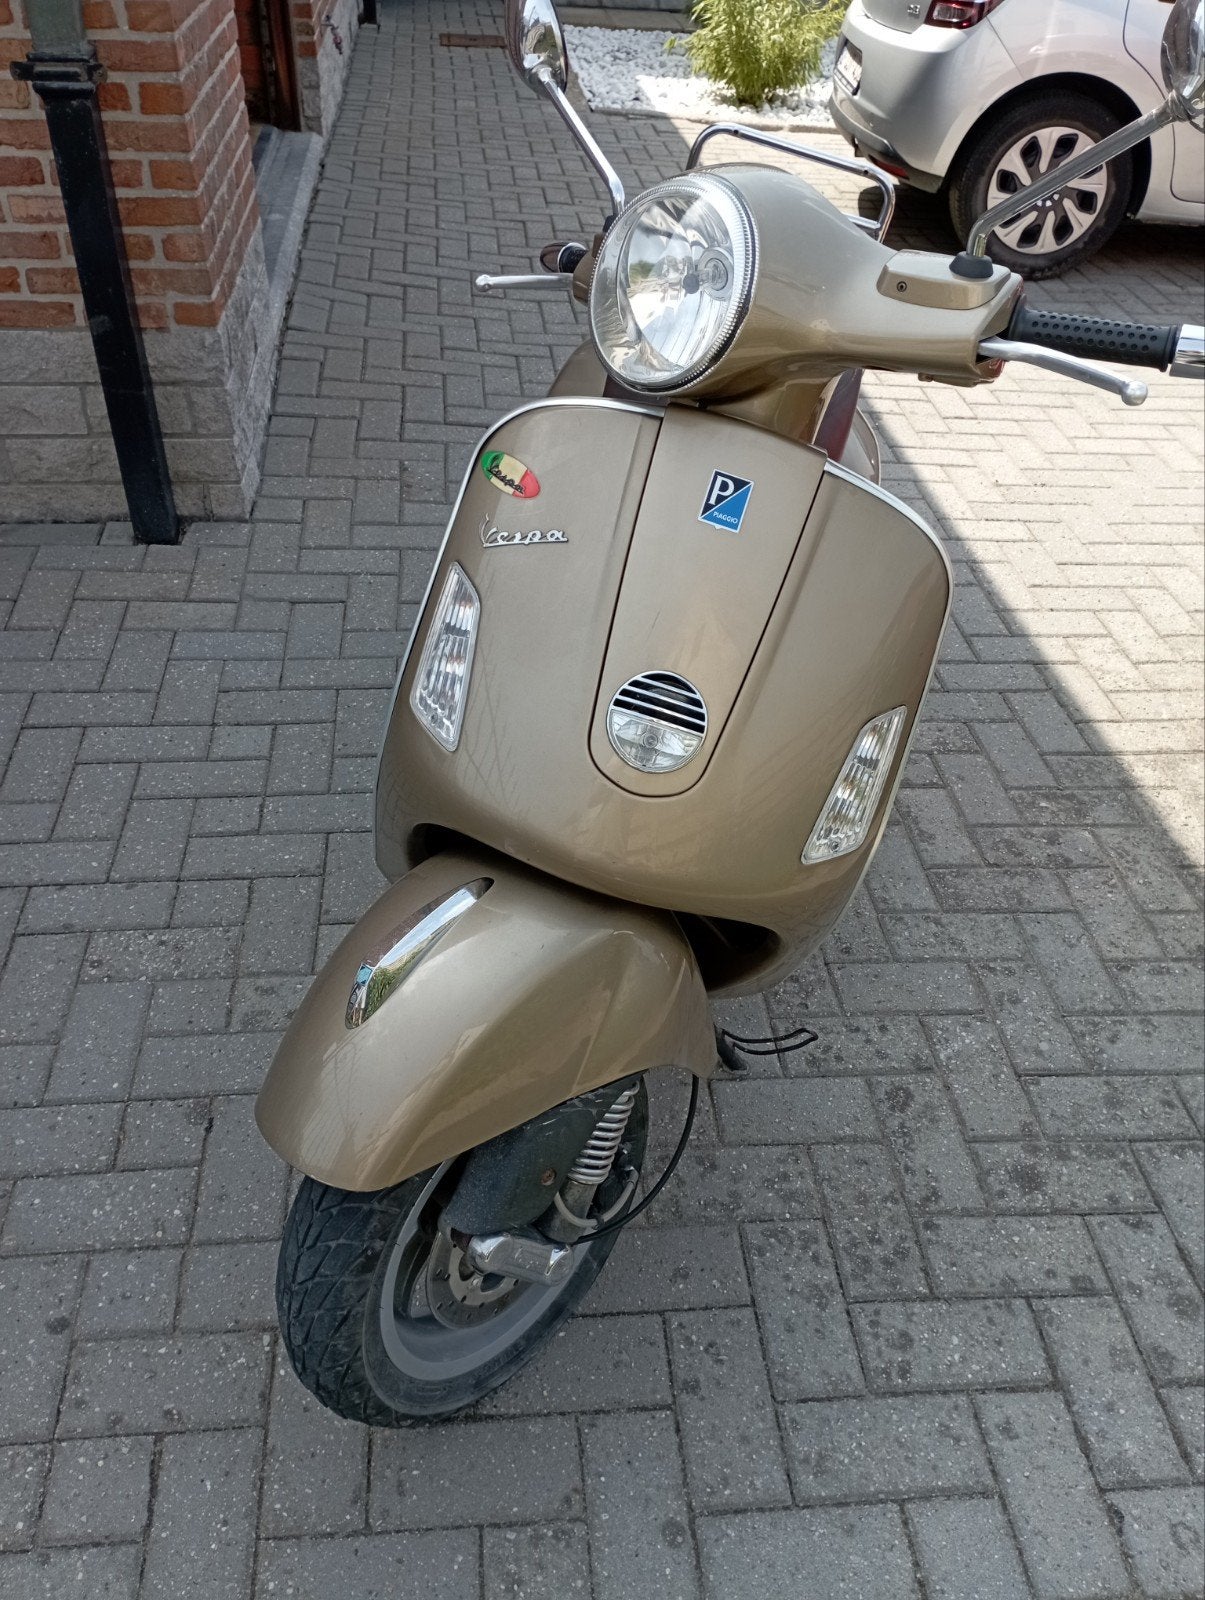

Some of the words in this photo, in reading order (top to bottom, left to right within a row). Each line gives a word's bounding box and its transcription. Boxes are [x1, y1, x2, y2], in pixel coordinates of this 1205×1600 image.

[487, 454, 525, 495] Vespa
[708, 474, 735, 505] P
[480, 513, 568, 548] Vespa
[713, 511, 739, 524] PIAGGIO
